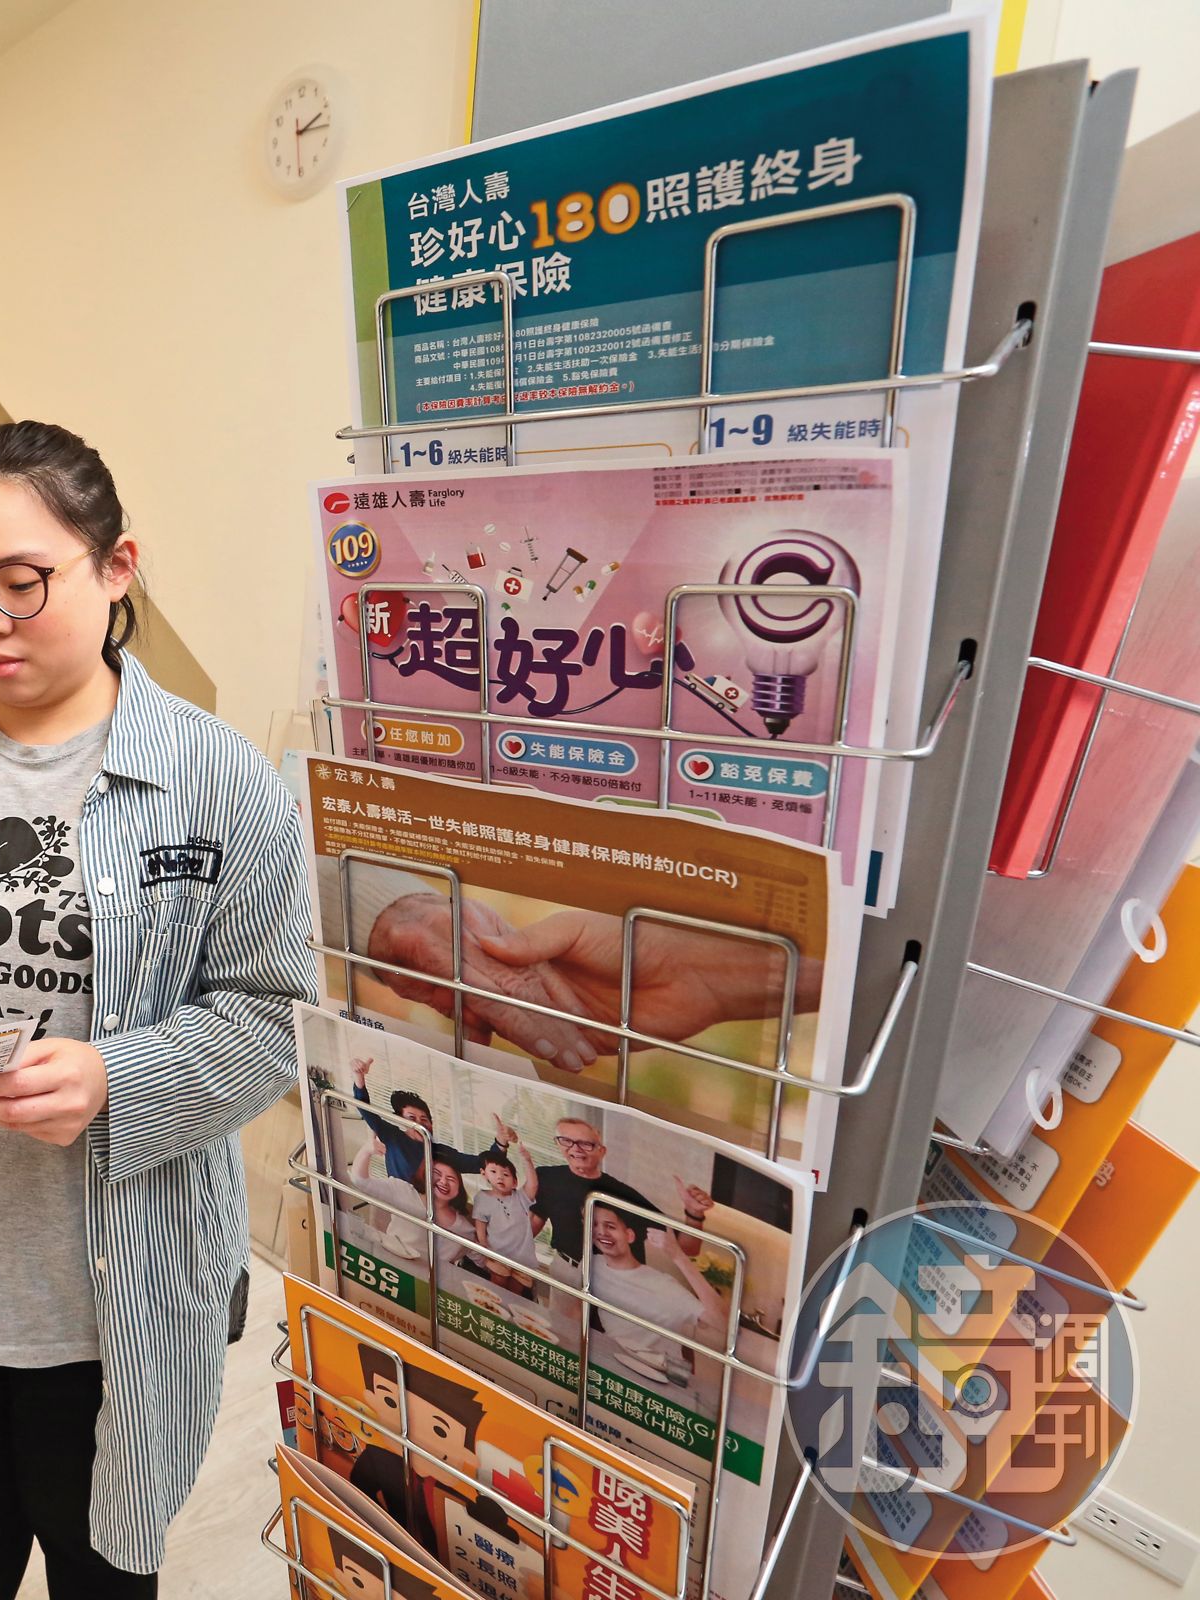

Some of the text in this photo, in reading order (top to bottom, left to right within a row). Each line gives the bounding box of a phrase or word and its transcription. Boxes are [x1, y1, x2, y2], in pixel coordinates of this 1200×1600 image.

[408, 170, 510, 220] 台灣人壽
[410, 137, 862, 268] 珍好心180照護終身
[413, 251, 572, 317] 健康保險
[787, 419, 882, 443] 級失能時
[448, 446, 507, 465] 級失能時
[353, 488, 465, 510] 遠雄人壽 Farglory
[429, 499, 446, 508] Life
[331, 531, 374, 565] 109
[365, 601, 391, 636] 新
[390, 727, 451, 747] 任您附加
[530, 742, 625, 766] 失能保險金
[334, 768, 395, 791] 宏泰人壽
[720, 762, 813, 787] 豁免保費
[322, 796, 738, 888] 宏泰人壽樂活一世失能照護終身健康保險附約(DCR)
[341, 1246, 400, 1284] LDG
[341, 1261, 400, 1299] LDH
[455, 1525, 515, 1570] 1.醫療
[456, 1548, 517, 1593] 2.長照
